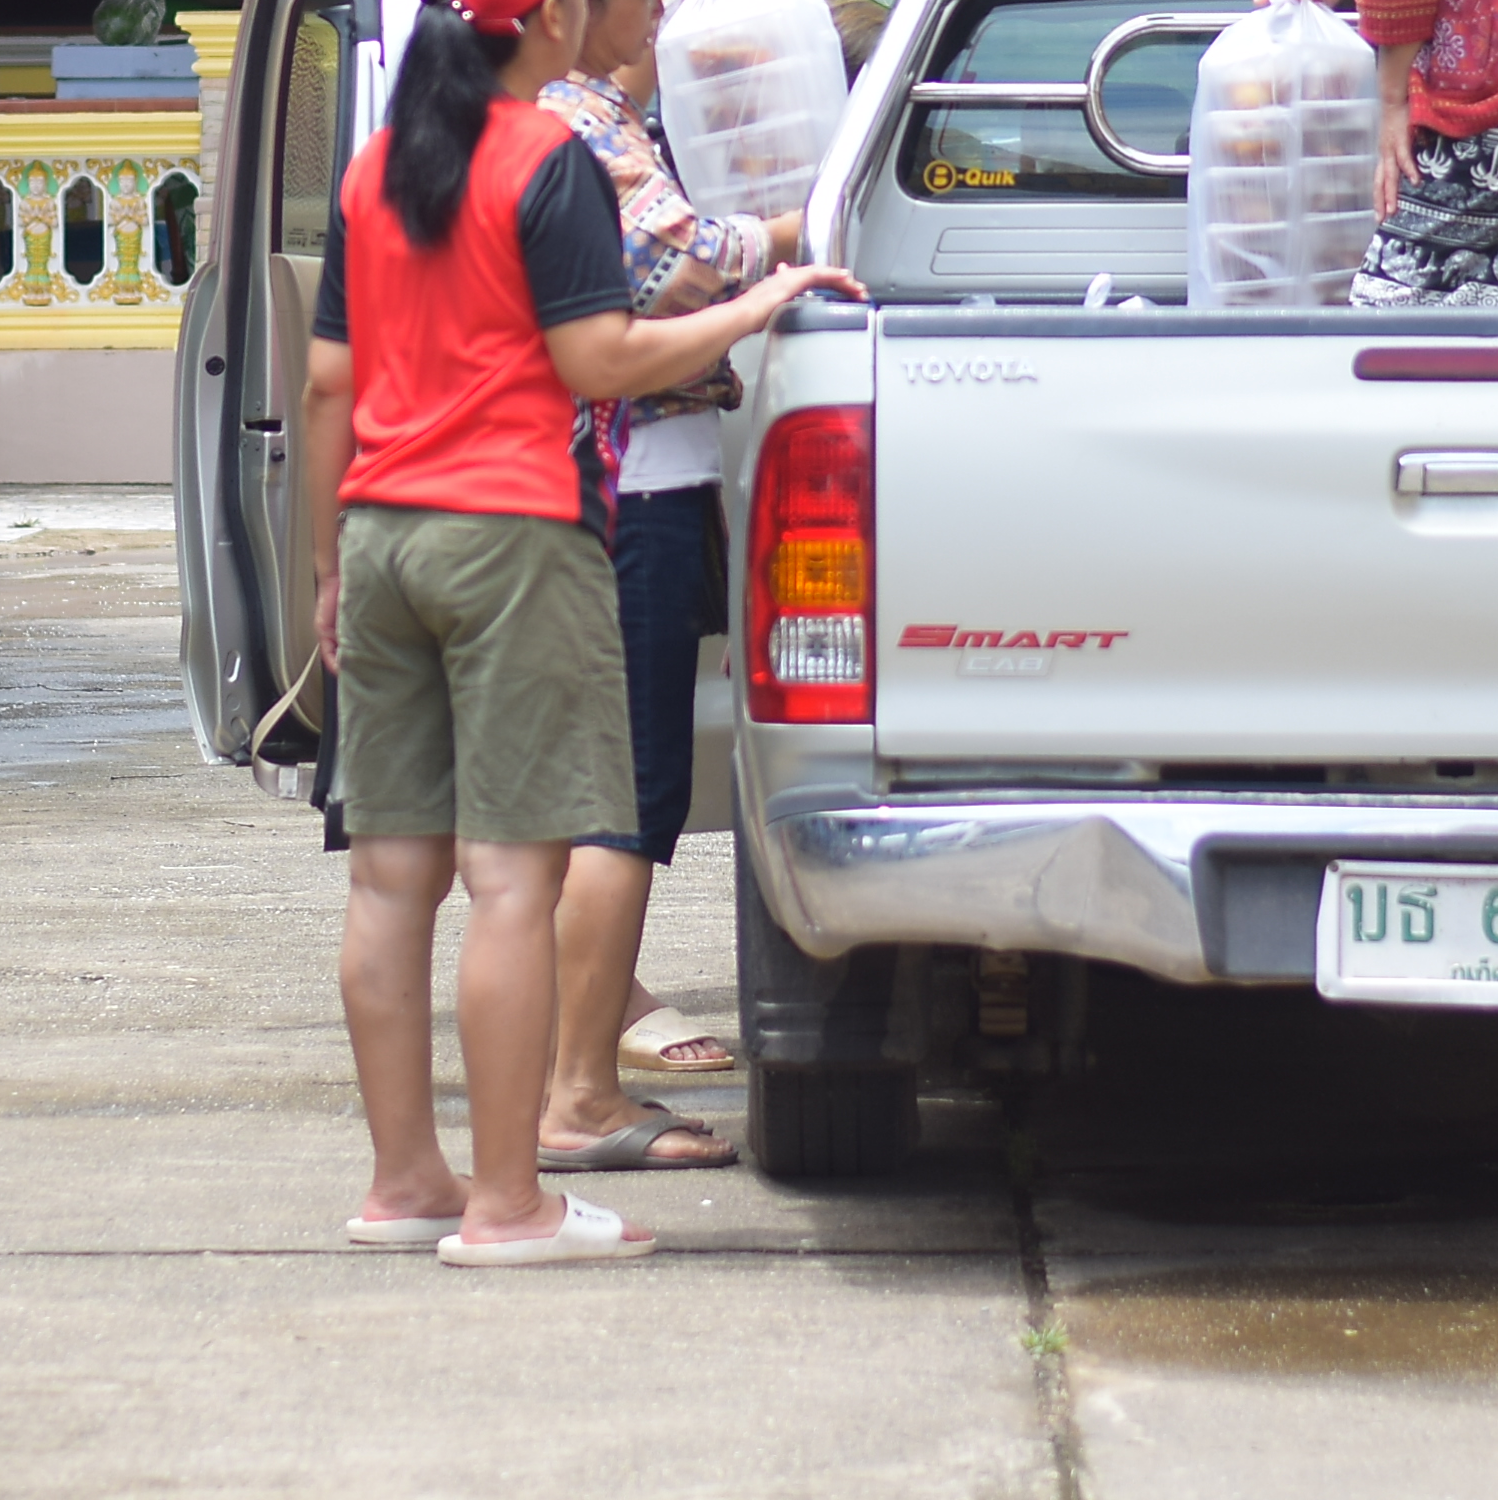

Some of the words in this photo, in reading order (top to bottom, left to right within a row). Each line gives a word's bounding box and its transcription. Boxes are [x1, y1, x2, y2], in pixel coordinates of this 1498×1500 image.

[901, 356, 1038, 384] TOYOTA
[965, 656, 1044, 671] CAB
[1346, 882, 1438, 942] บธ
